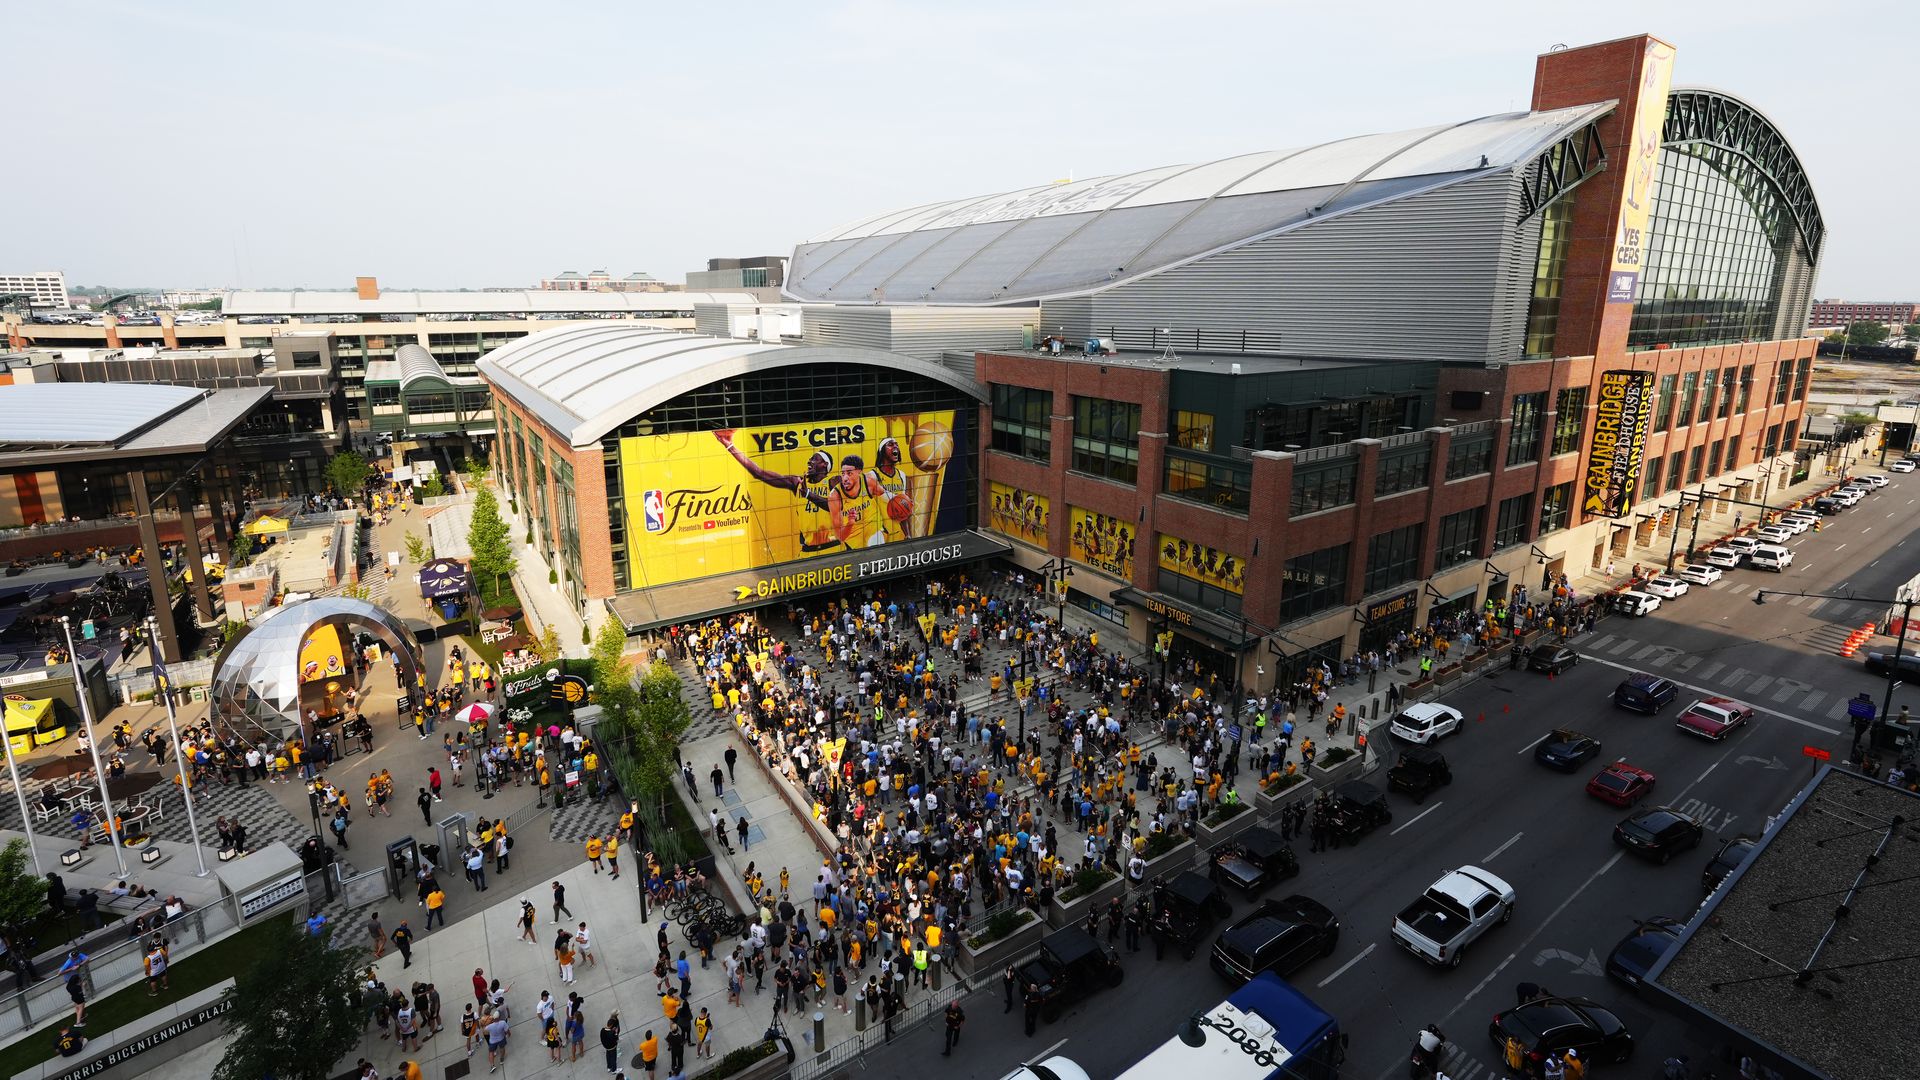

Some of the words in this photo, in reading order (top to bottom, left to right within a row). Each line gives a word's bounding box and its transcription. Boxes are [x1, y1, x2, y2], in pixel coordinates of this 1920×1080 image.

[1624, 228, 1640, 246] YES
[1616, 246, 1640, 265] 'CERS
[751, 431, 799, 453] YES
[803, 424, 865, 447] 'CERS
[1587, 373, 1628, 490] GAINBRIDGE
[1612, 386, 1640, 480] FIELDHOUSE
[1625, 374, 1653, 492] GAINBRIDGE
[657, 484, 753, 536] Finals
[678, 525, 695, 533] Presented
[716, 518, 741, 528] YouTube
[741, 516, 750, 524] TV
[757, 564, 852, 597] GAINBRIDGE
[858, 544, 962, 577] FIELDHOUSE
[1086, 555, 1100, 567] YES
[1145, 598, 1166, 616] TEAM
[1167, 607, 1192, 626] STORE
[1372, 603, 1387, 620] TEAM
[1387, 597, 1406, 615] STORE
[58, 1060, 104, 1080] ORRIS
[108, 1019, 195, 1065] BICENTENNIAL
[199, 1000, 233, 1022] PLAZA
